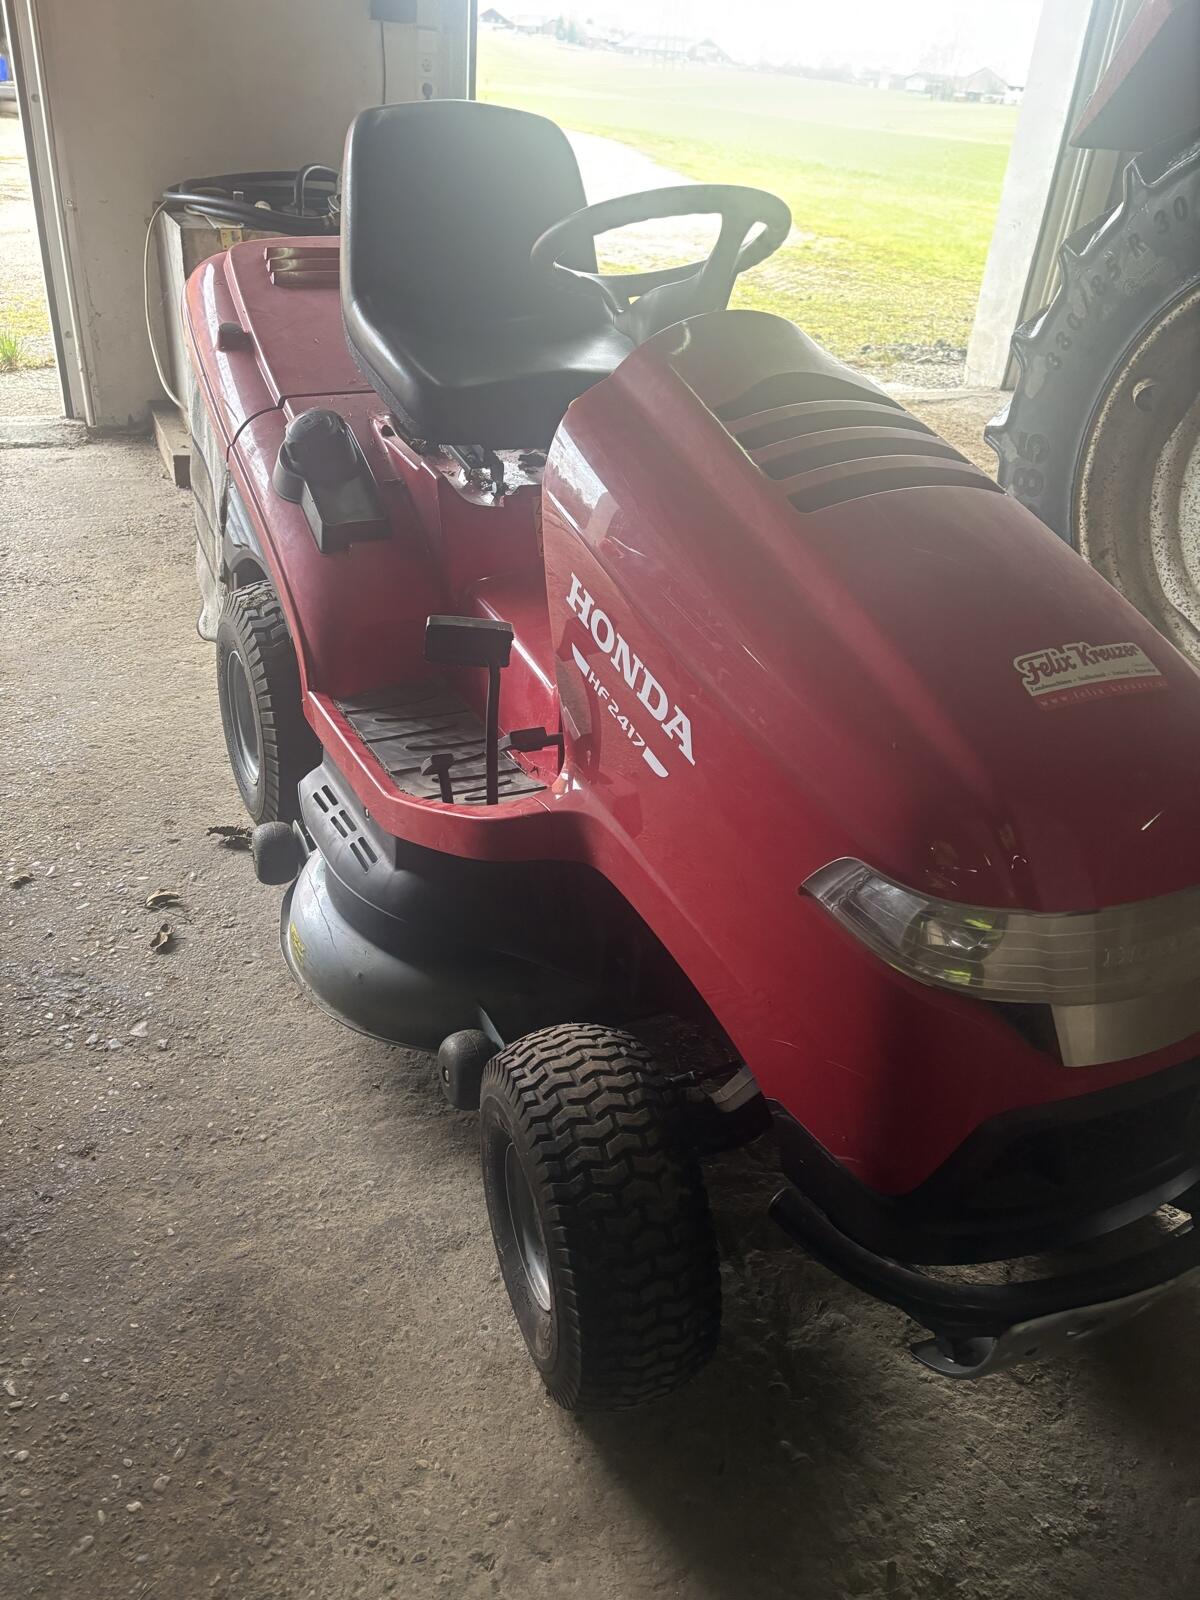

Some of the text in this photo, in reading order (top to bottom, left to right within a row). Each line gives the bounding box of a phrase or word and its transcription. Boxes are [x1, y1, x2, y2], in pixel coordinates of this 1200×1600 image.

[1153, 195, 1188, 234] 30
[565, 571, 696, 766] HONDA
[1016, 648, 1077, 686] Felix
[1066, 643, 1140, 667] Kreuzer
